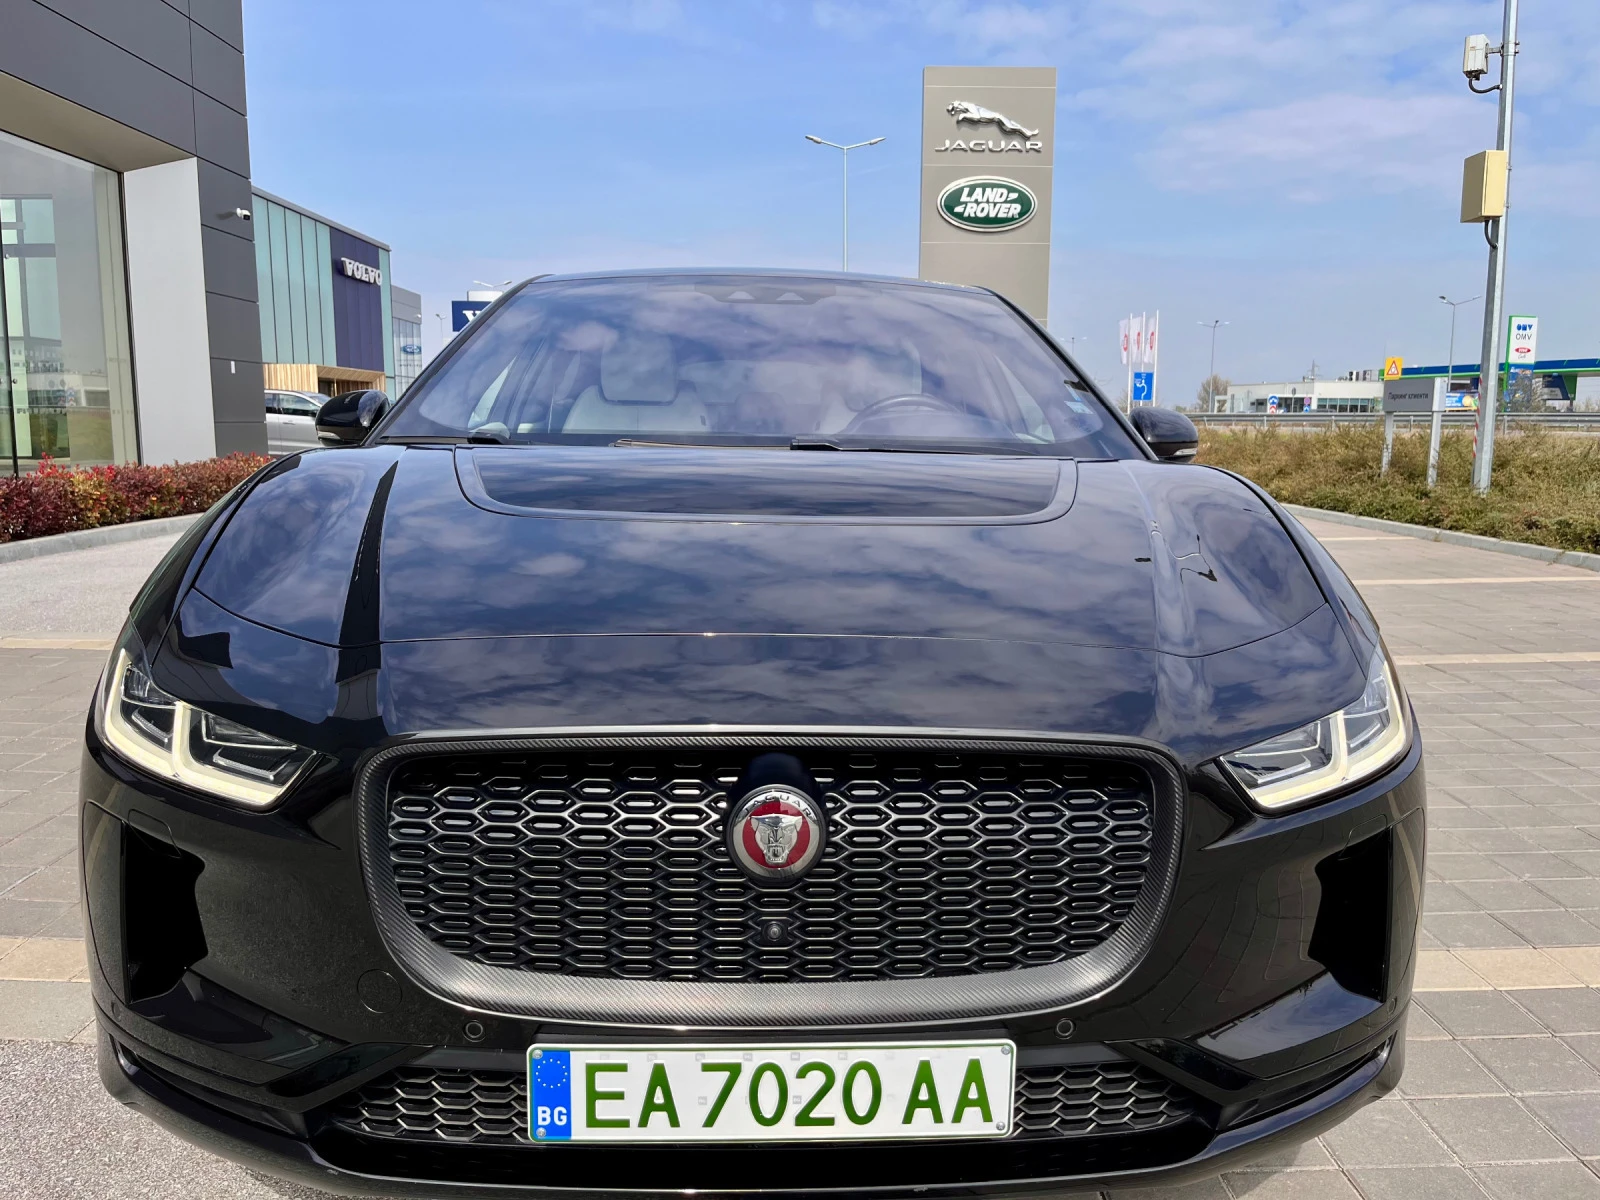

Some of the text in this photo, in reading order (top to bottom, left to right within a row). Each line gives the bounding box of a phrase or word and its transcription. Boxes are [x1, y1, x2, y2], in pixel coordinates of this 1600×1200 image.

[935, 139, 1043, 153] JAGUAR
[959, 187, 1008, 203] LAND
[963, 202, 1022, 218] ROVER
[341, 257, 383, 286] VOLVO
[1515, 333, 1533, 341] OMV
[743, 794, 813, 818] JAGUAR
[585, 1058, 994, 1129] EA 7020 AA
[537, 1106, 568, 1126] BG
